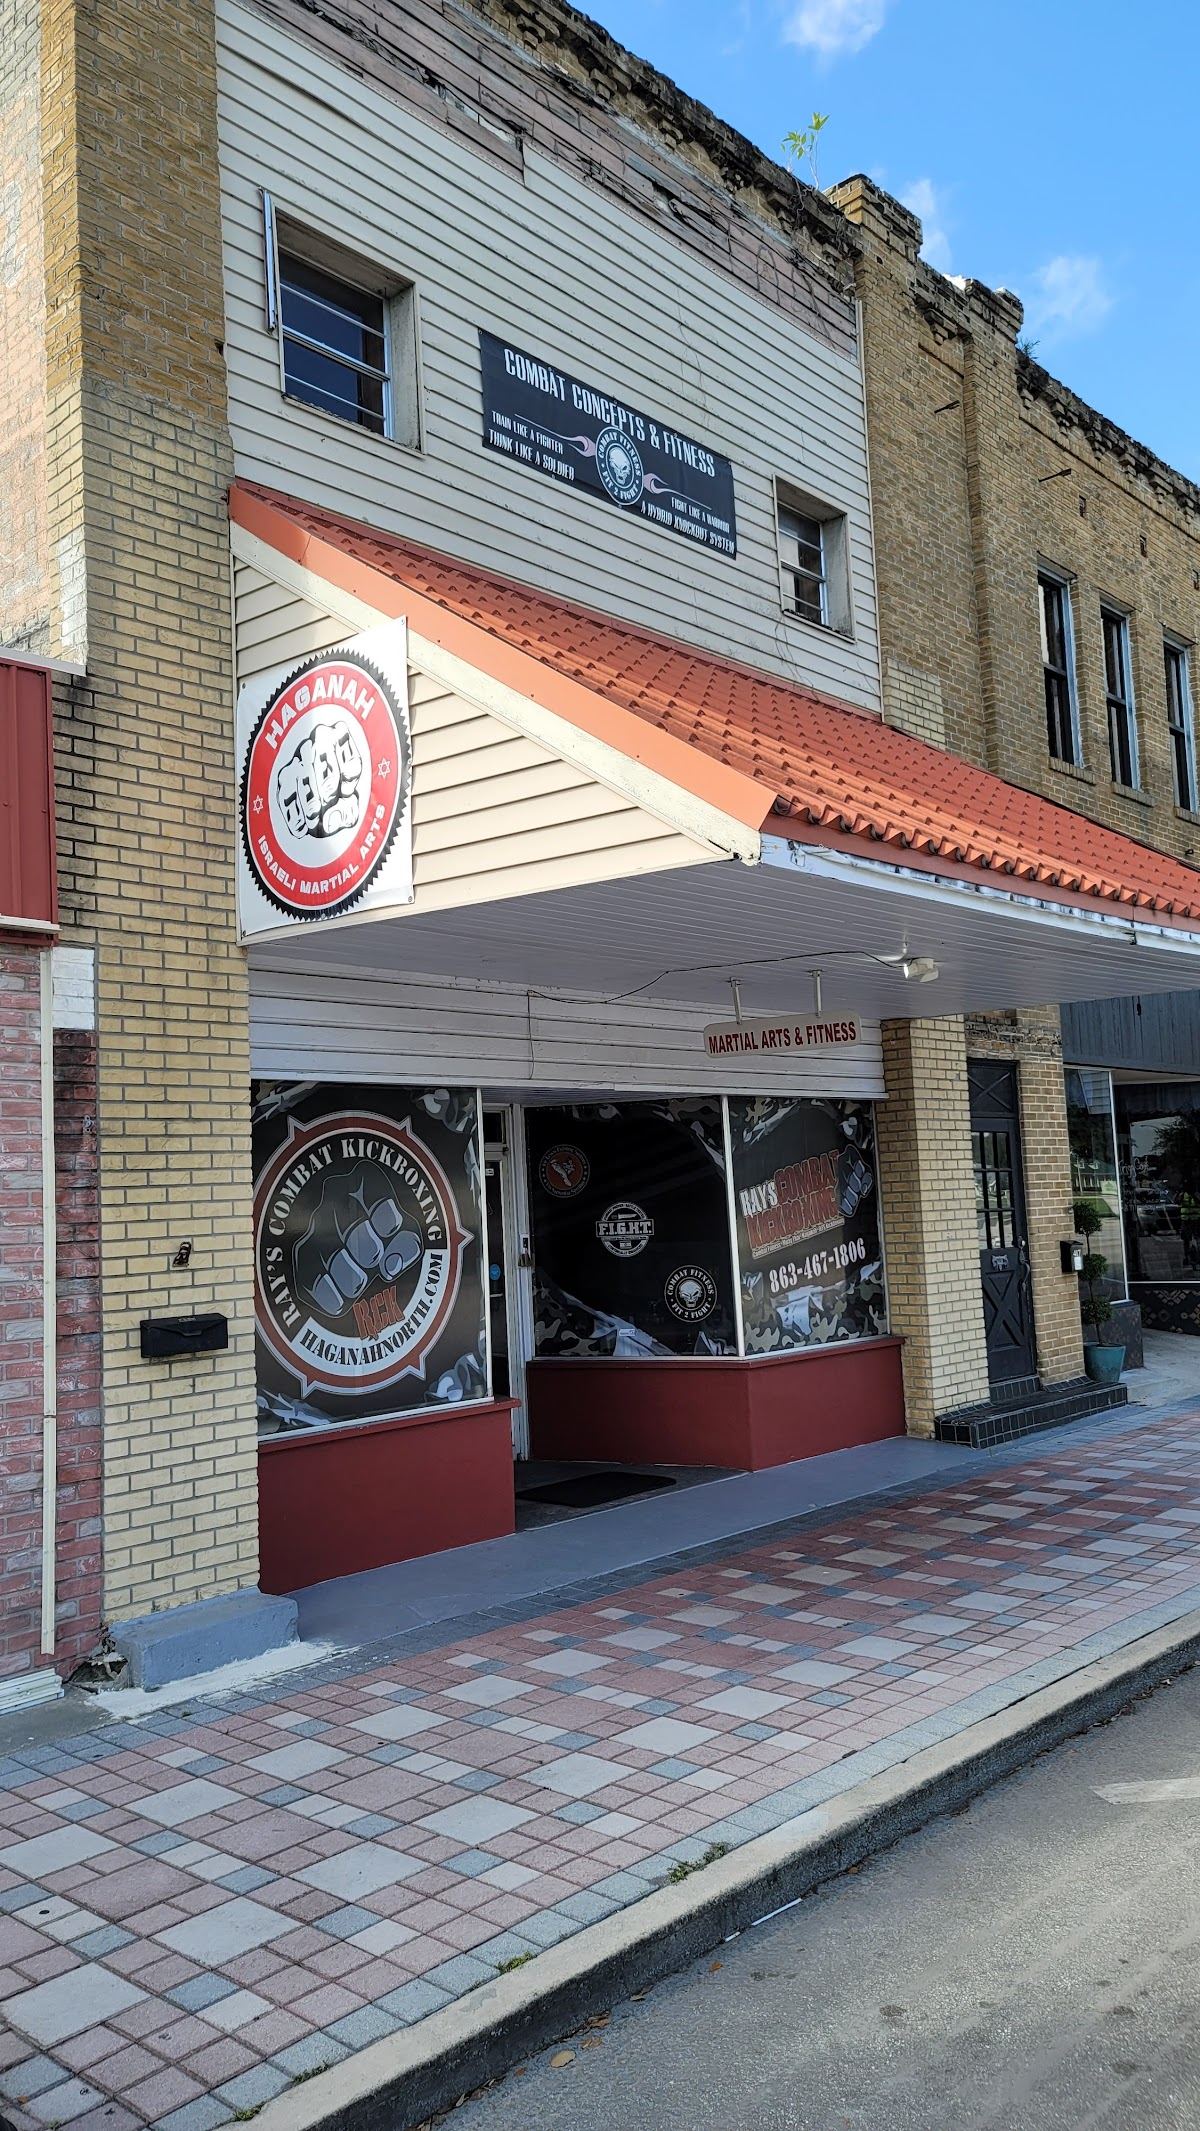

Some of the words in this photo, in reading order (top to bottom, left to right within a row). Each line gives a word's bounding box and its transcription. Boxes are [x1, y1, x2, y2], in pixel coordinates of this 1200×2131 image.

[492, 410, 512, 430] TRAIN
[513, 421, 528, 438] LIKE
[529, 429, 535, 441] A
[536, 432, 563, 454] FIGHTER
[504, 348, 566, 401] COMBAT
[572, 383, 645, 441] CONCEPTS
[649, 424, 660, 449] &
[663, 432, 715, 477] FITNESS
[489, 428, 513, 452] THINK
[515, 441, 532, 461] LIKE
[534, 451, 540, 465] A
[542, 454, 575, 480] SOLDIER
[598, 432, 617, 458] COMBAT
[620, 435, 641, 476] FITNESS
[602, 471, 613, 488] FIT
[620, 484, 638, 500] FIGHT
[640, 500, 646, 514] A
[647, 503, 673, 526] HYBRID
[674, 515, 708, 541] KNOCKOUT
[709, 532, 735, 554] SYSTEM
[671, 497, 687, 513] FIGHT
[688, 505, 701, 519] LIKE
[707, 513, 730, 533] WARRIOR
[264, 674, 376, 750] HAGANAH
[258, 835, 295, 891] ISRAELI
[299, 863, 359, 895] MARTIAL
[359, 804, 386, 857] ARTS
[708, 1031, 758, 1054] MARTIAL
[761, 1028, 790, 1049] ARTS
[794, 1026, 803, 1045] &
[806, 1021, 857, 1045] FITNESS
[268, 1144, 332, 1237] COMBAT
[341, 1138, 443, 1242] KICKBOXING
[599, 1221, 652, 1236] F.I.G.H.T.
[266, 1247, 301, 1328] RAY'S
[667, 1269, 688, 1296] COMBAT
[690, 1269, 714, 1294] FITNESS
[769, 1238, 866, 1293] 863-467-1806
[300, 1252, 443, 1366] HAGANAHNORTH.COM
[672, 1303, 683, 1315] FIT
[691, 1302, 711, 1319] FIGHT
